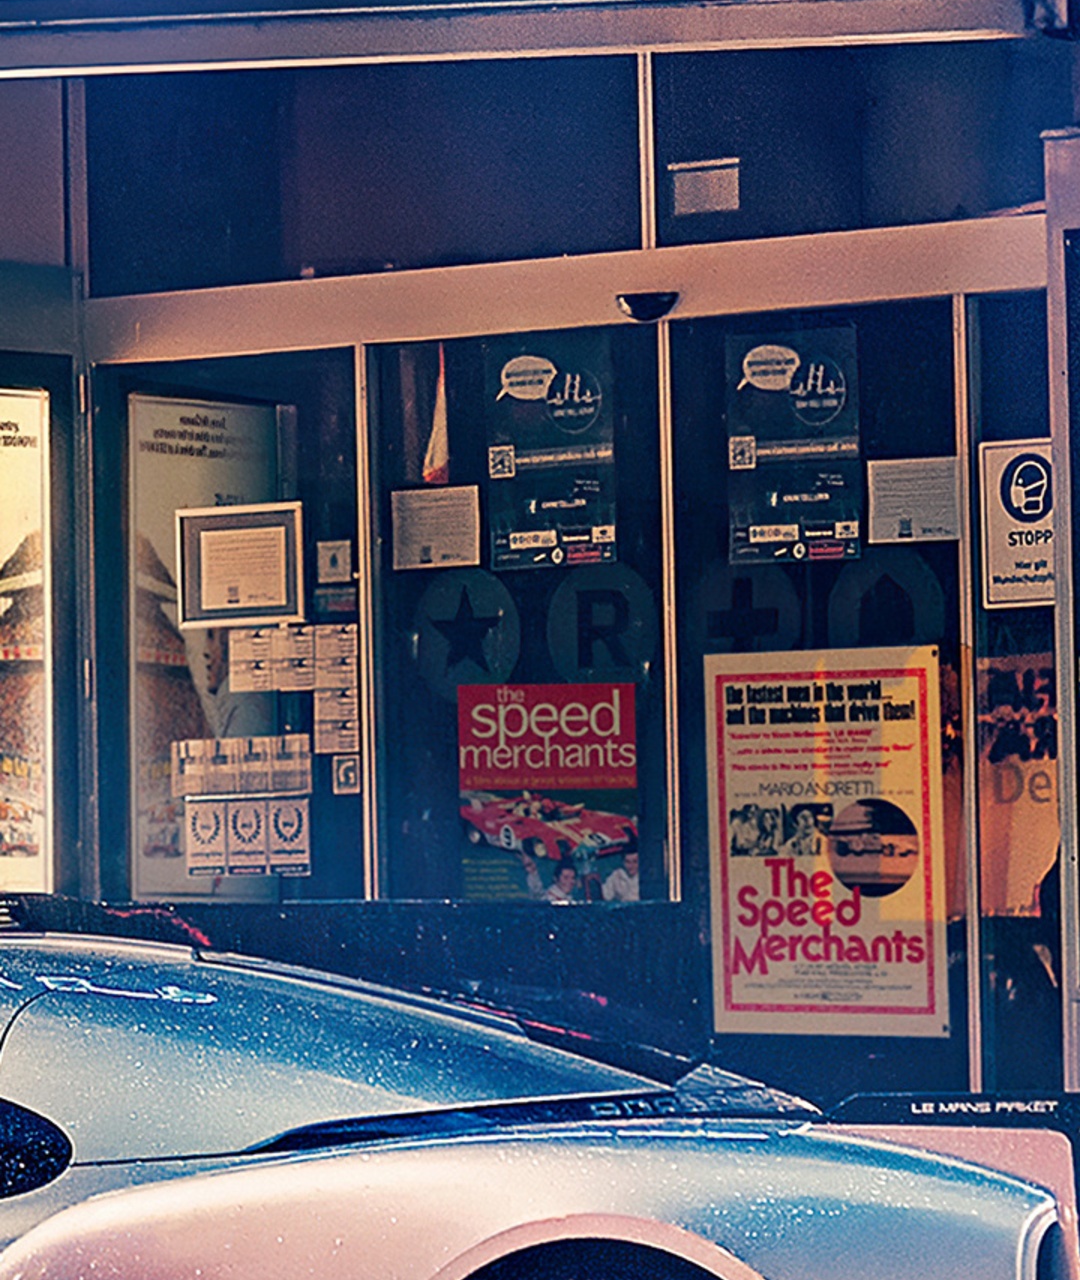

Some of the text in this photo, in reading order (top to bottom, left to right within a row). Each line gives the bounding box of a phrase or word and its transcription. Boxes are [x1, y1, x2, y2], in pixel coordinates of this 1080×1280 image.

[1008, 529, 1053, 547] STOPP
[497, 685, 525, 702] the
[471, 689, 620, 746] speed
[460, 736, 637, 769] merchants
[759, 782, 804, 797] MARIO
[805, 781, 875, 796] ANDRETTI
[764, 858, 834, 898] The
[737, 886, 861, 938] Speed
[732, 926, 926, 975] Merchants
[911, 1102, 935, 1114] LE
[938, 1101, 991, 1114] MANS
